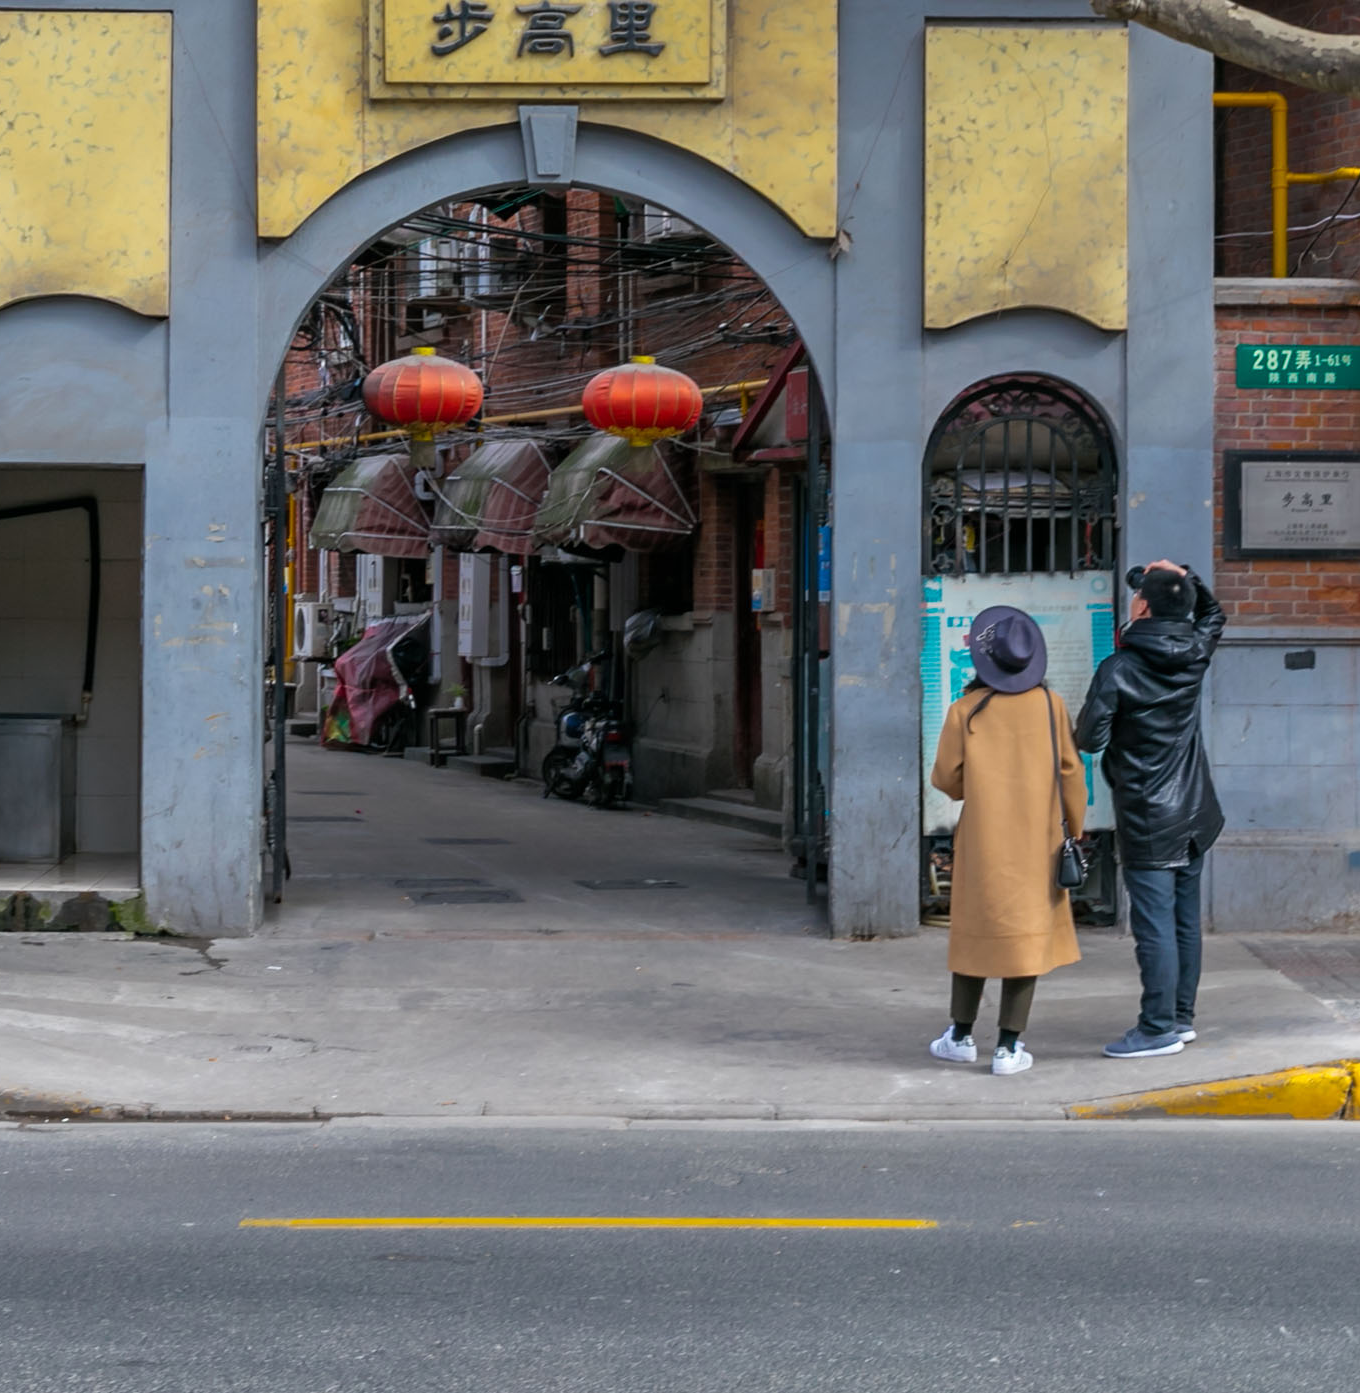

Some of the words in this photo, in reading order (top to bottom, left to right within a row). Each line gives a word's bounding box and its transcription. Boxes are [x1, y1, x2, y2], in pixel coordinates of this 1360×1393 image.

[1268, 372, 1337, 385] 陕西南路
[1281, 491, 1334, 508] 步高里
